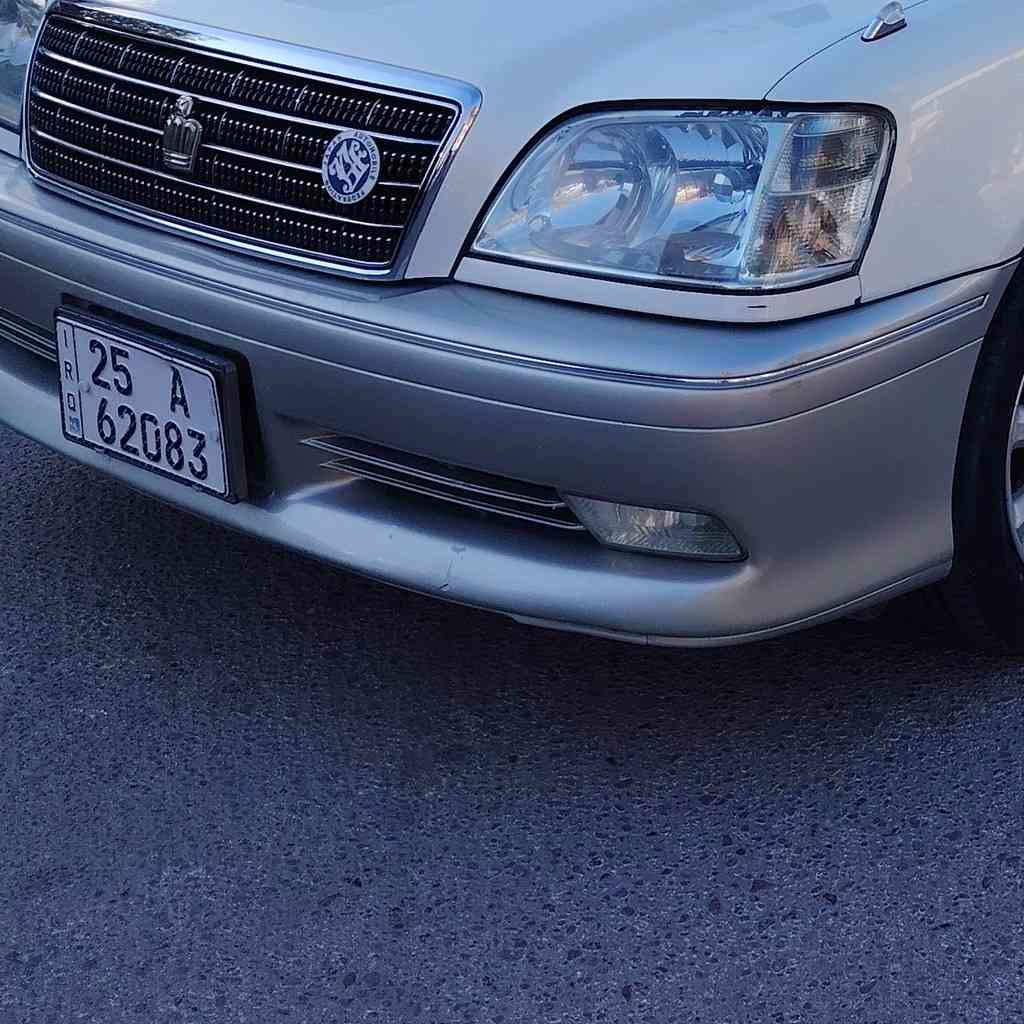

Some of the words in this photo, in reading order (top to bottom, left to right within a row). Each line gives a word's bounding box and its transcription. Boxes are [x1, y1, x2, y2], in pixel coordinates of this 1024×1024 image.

[89, 339, 132, 396] 25
[170, 366, 191, 418] A
[97, 397, 208, 481] 62083
